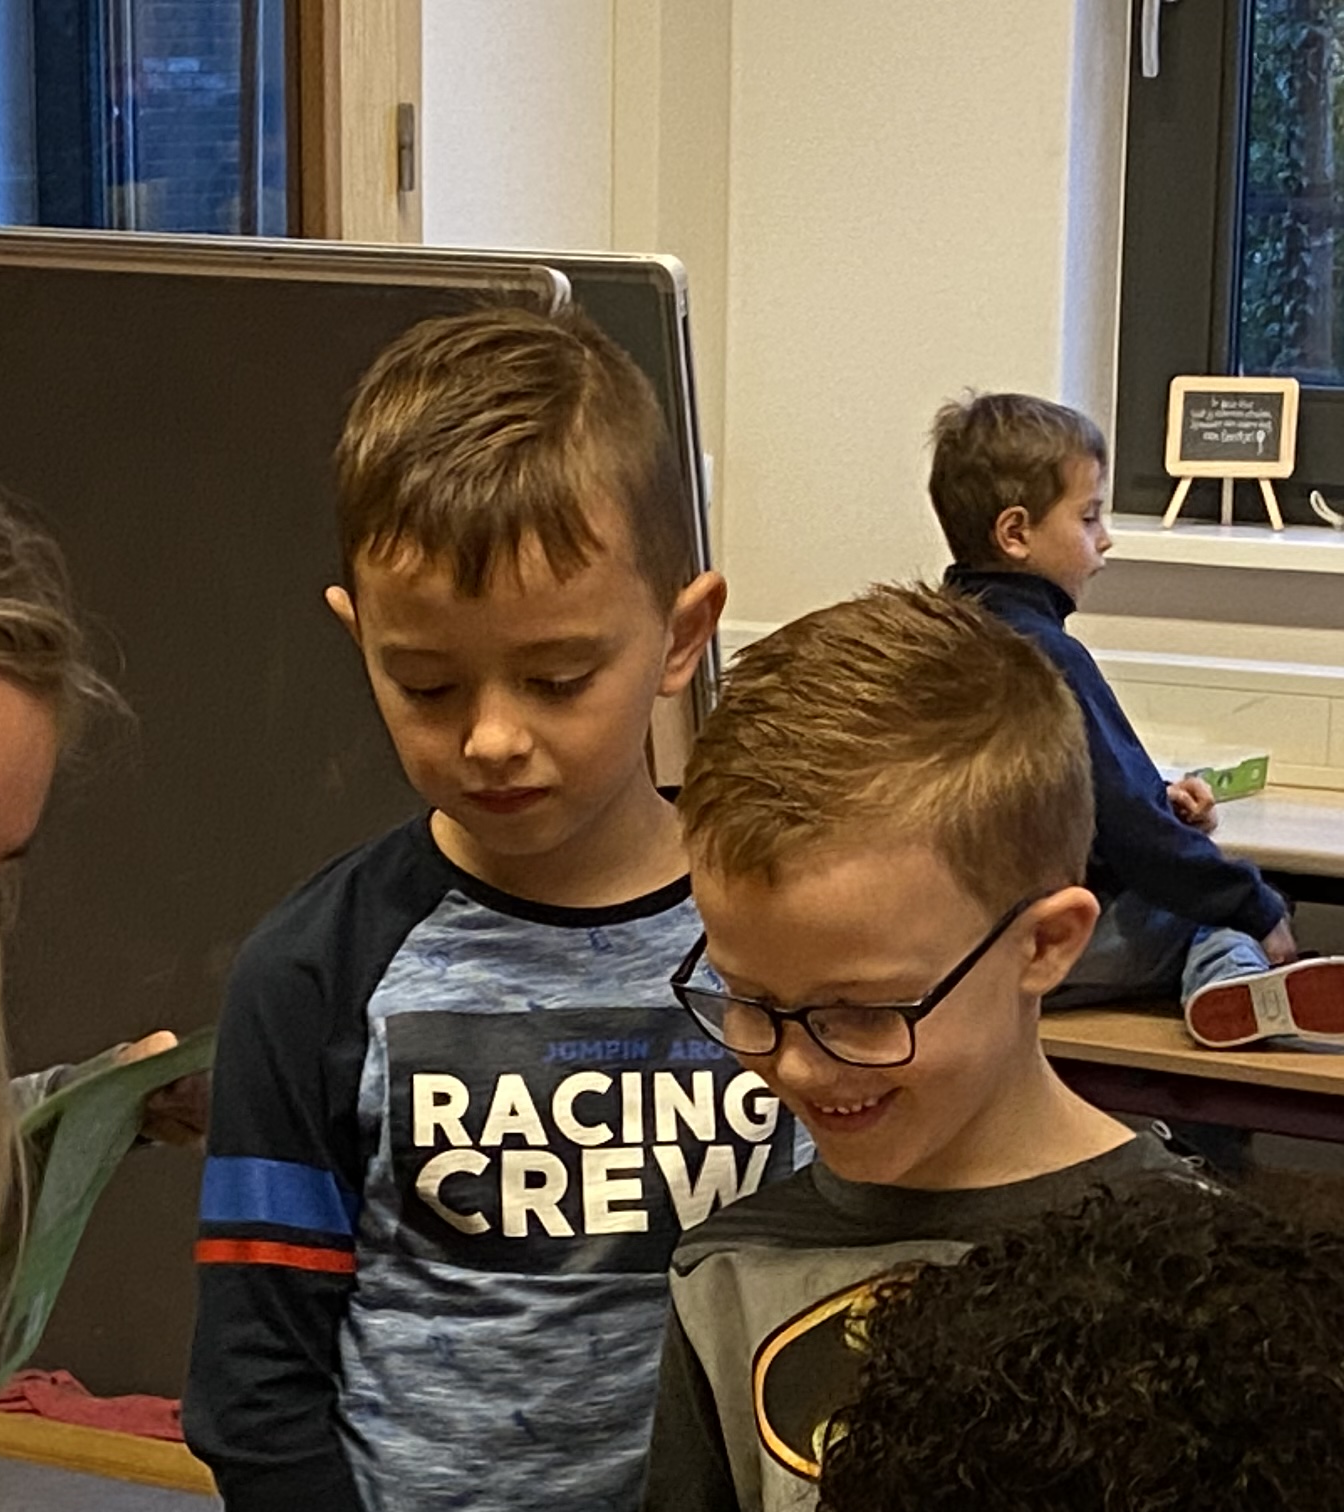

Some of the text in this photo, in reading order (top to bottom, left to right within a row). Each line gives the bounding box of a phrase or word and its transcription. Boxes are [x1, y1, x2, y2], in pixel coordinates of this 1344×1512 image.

[669, 1039, 728, 1061] ARO
[412, 1071, 780, 1148] RACING
[415, 1144, 772, 1238] CREW
